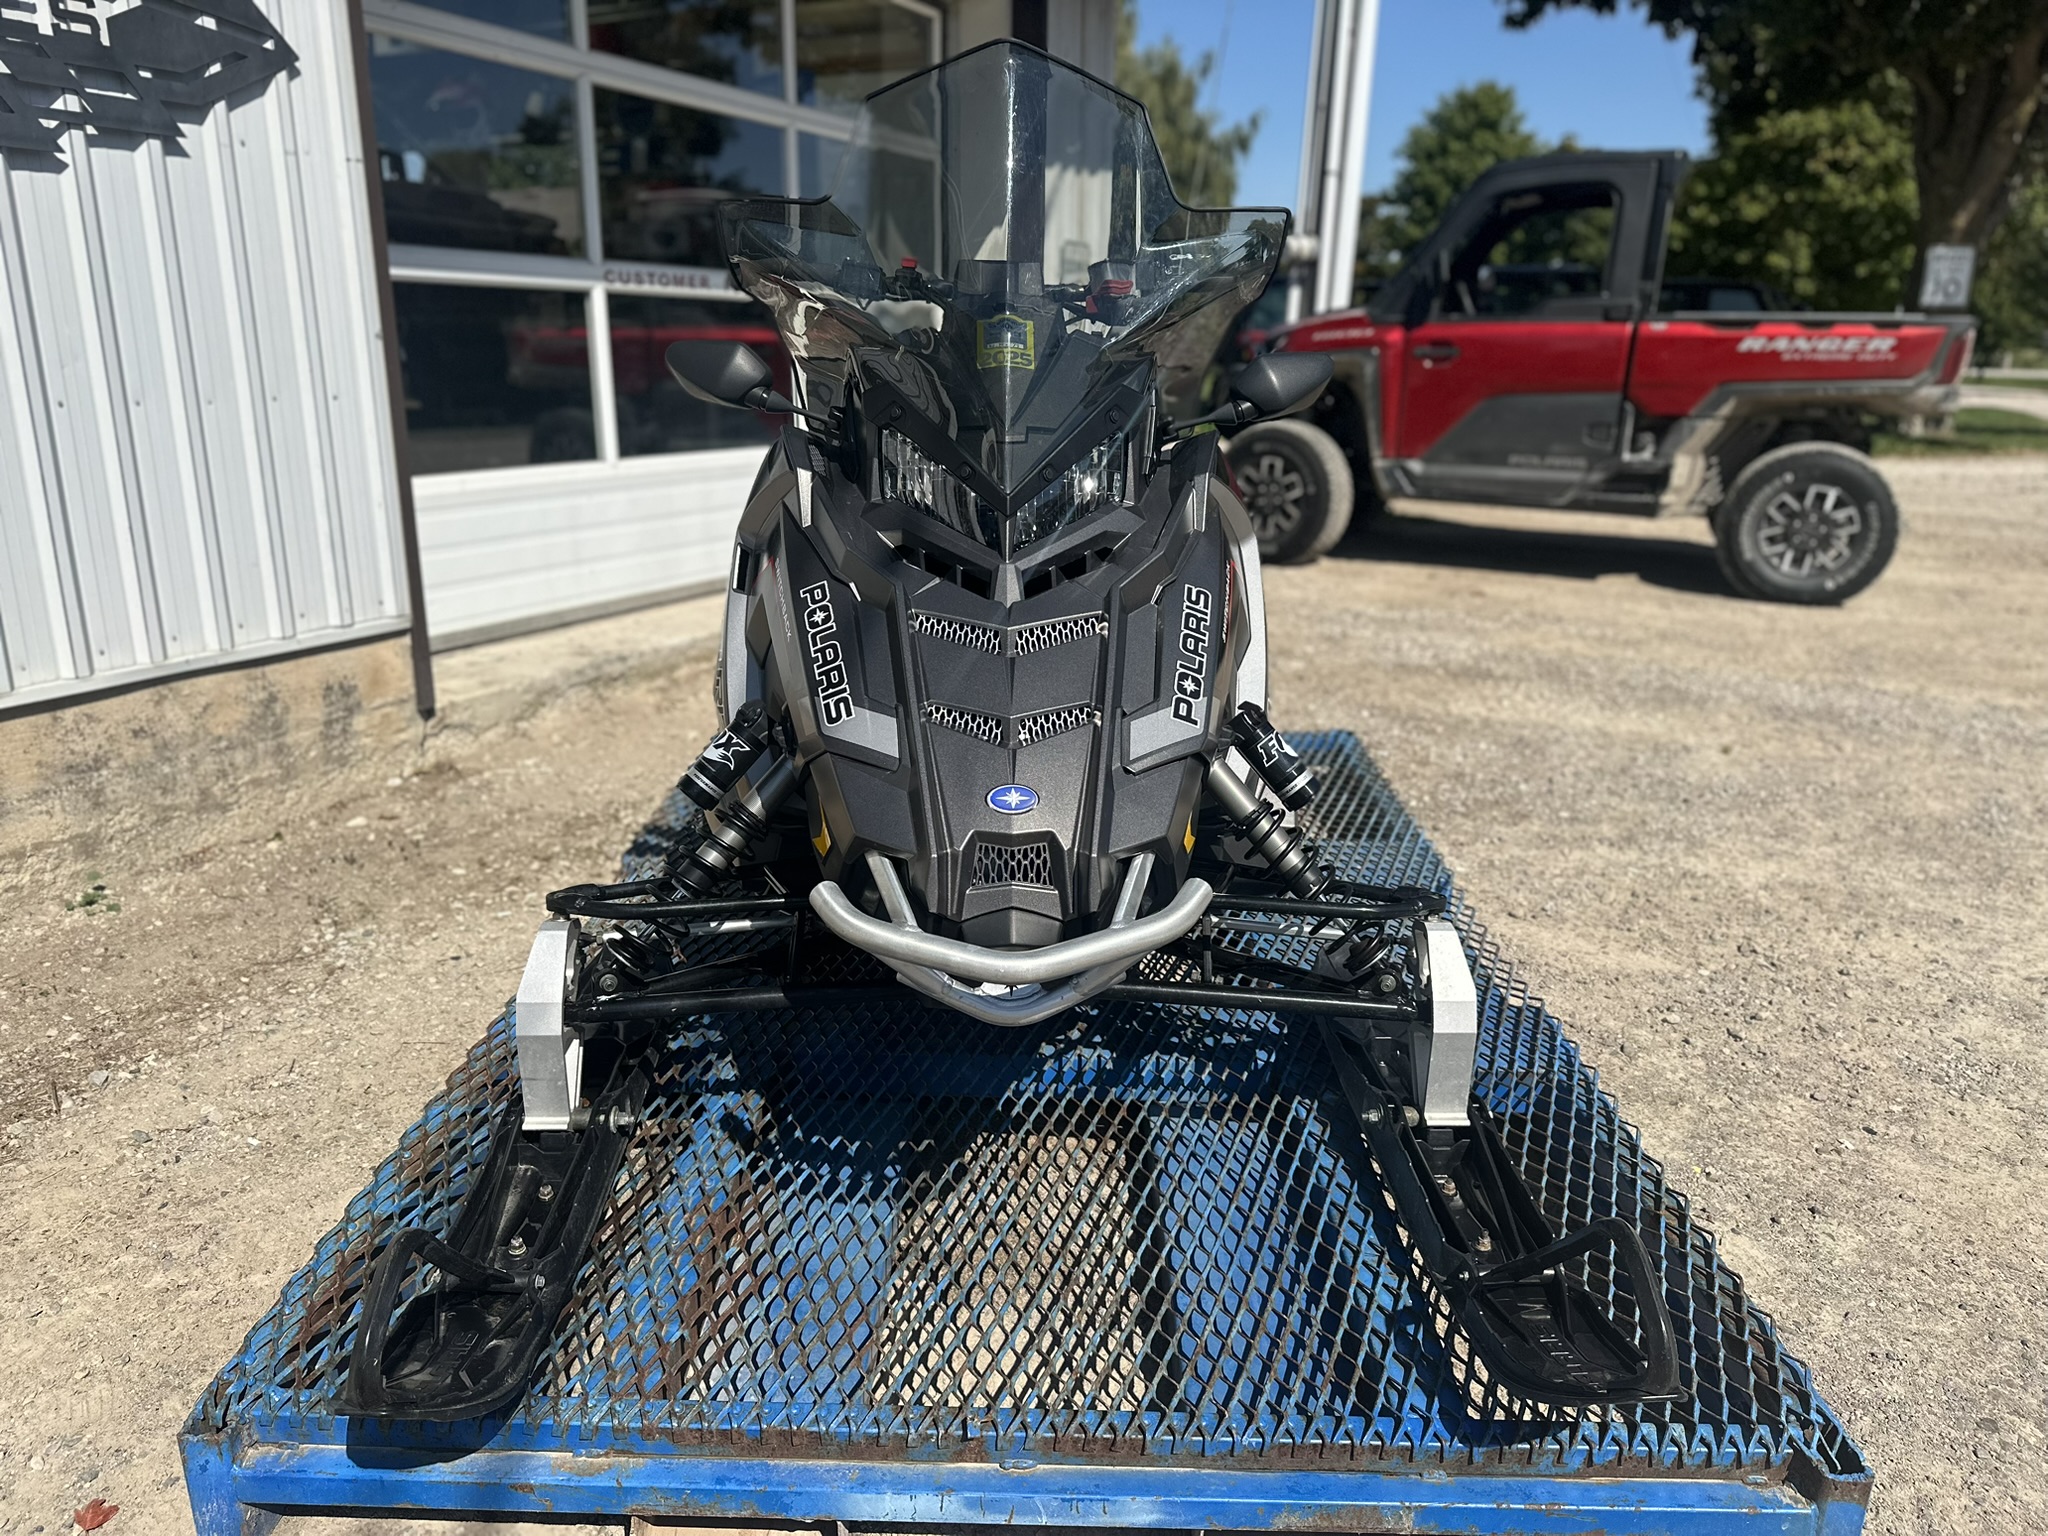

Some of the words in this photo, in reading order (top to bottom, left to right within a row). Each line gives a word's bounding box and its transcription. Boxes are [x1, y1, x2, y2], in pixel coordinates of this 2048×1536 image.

[603, 268, 711, 288] CUSTOMER
[979, 350, 1033, 367] 2025
[1736, 336, 1898, 353] RANGER
[774, 557, 792, 643] SWITCHBACK
[799, 580, 856, 727] POLARIS
[1170, 583, 1212, 728] POLARIS
